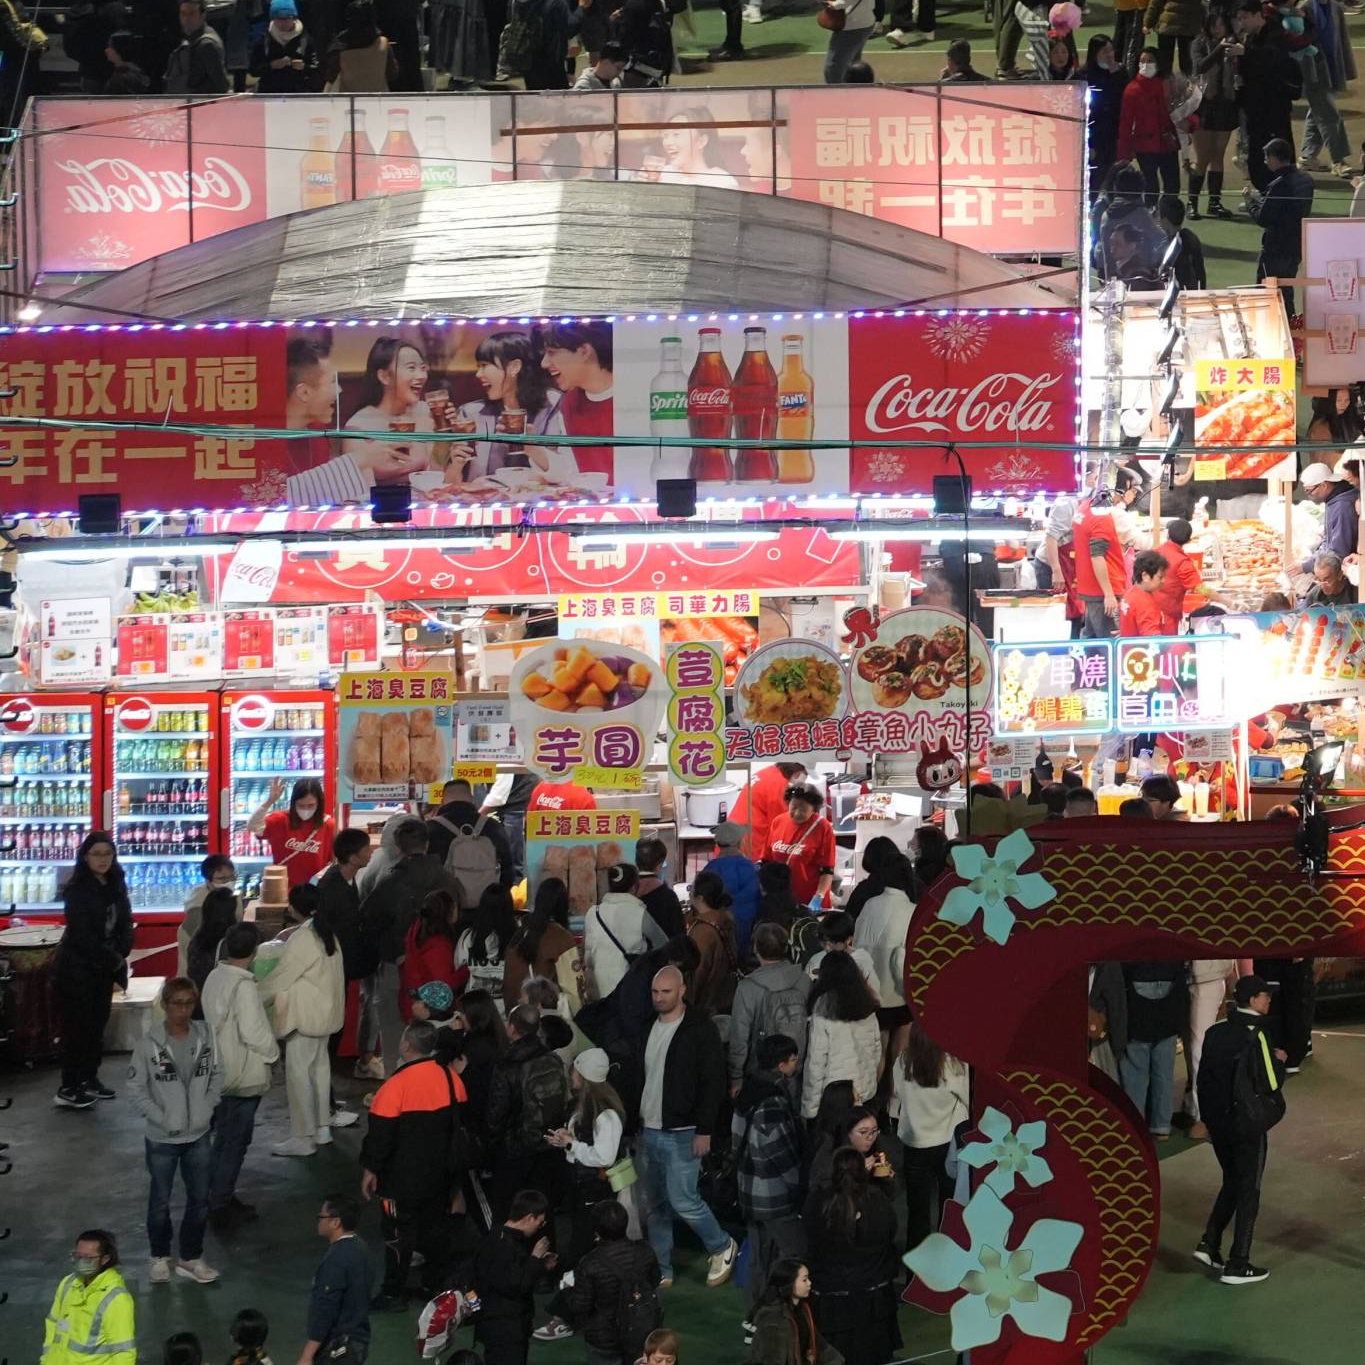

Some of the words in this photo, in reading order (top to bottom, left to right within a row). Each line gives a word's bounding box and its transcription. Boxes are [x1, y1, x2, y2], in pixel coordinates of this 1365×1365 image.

[0, 356, 257, 417] 綻放祝福
[1209, 365, 1281, 386] 炸大腸
[688, 388, 730, 406] Coca-Cola
[865, 373, 1064, 434] Coca-Cola
[562, 596, 655, 618] 上海臭豆腐
[668, 594, 751, 613] 司華力腸
[1050, 655, 1108, 689] 串燒
[345, 677, 448, 700] 上海臭豆腐
[677, 649, 715, 777] 荳腐花
[941, 700, 978, 711] Takoyki
[855, 712, 991, 752] 章魚小丸子
[536, 726, 640, 772] 芋圓
[535, 814, 632, 837] 上海臭豆腐
